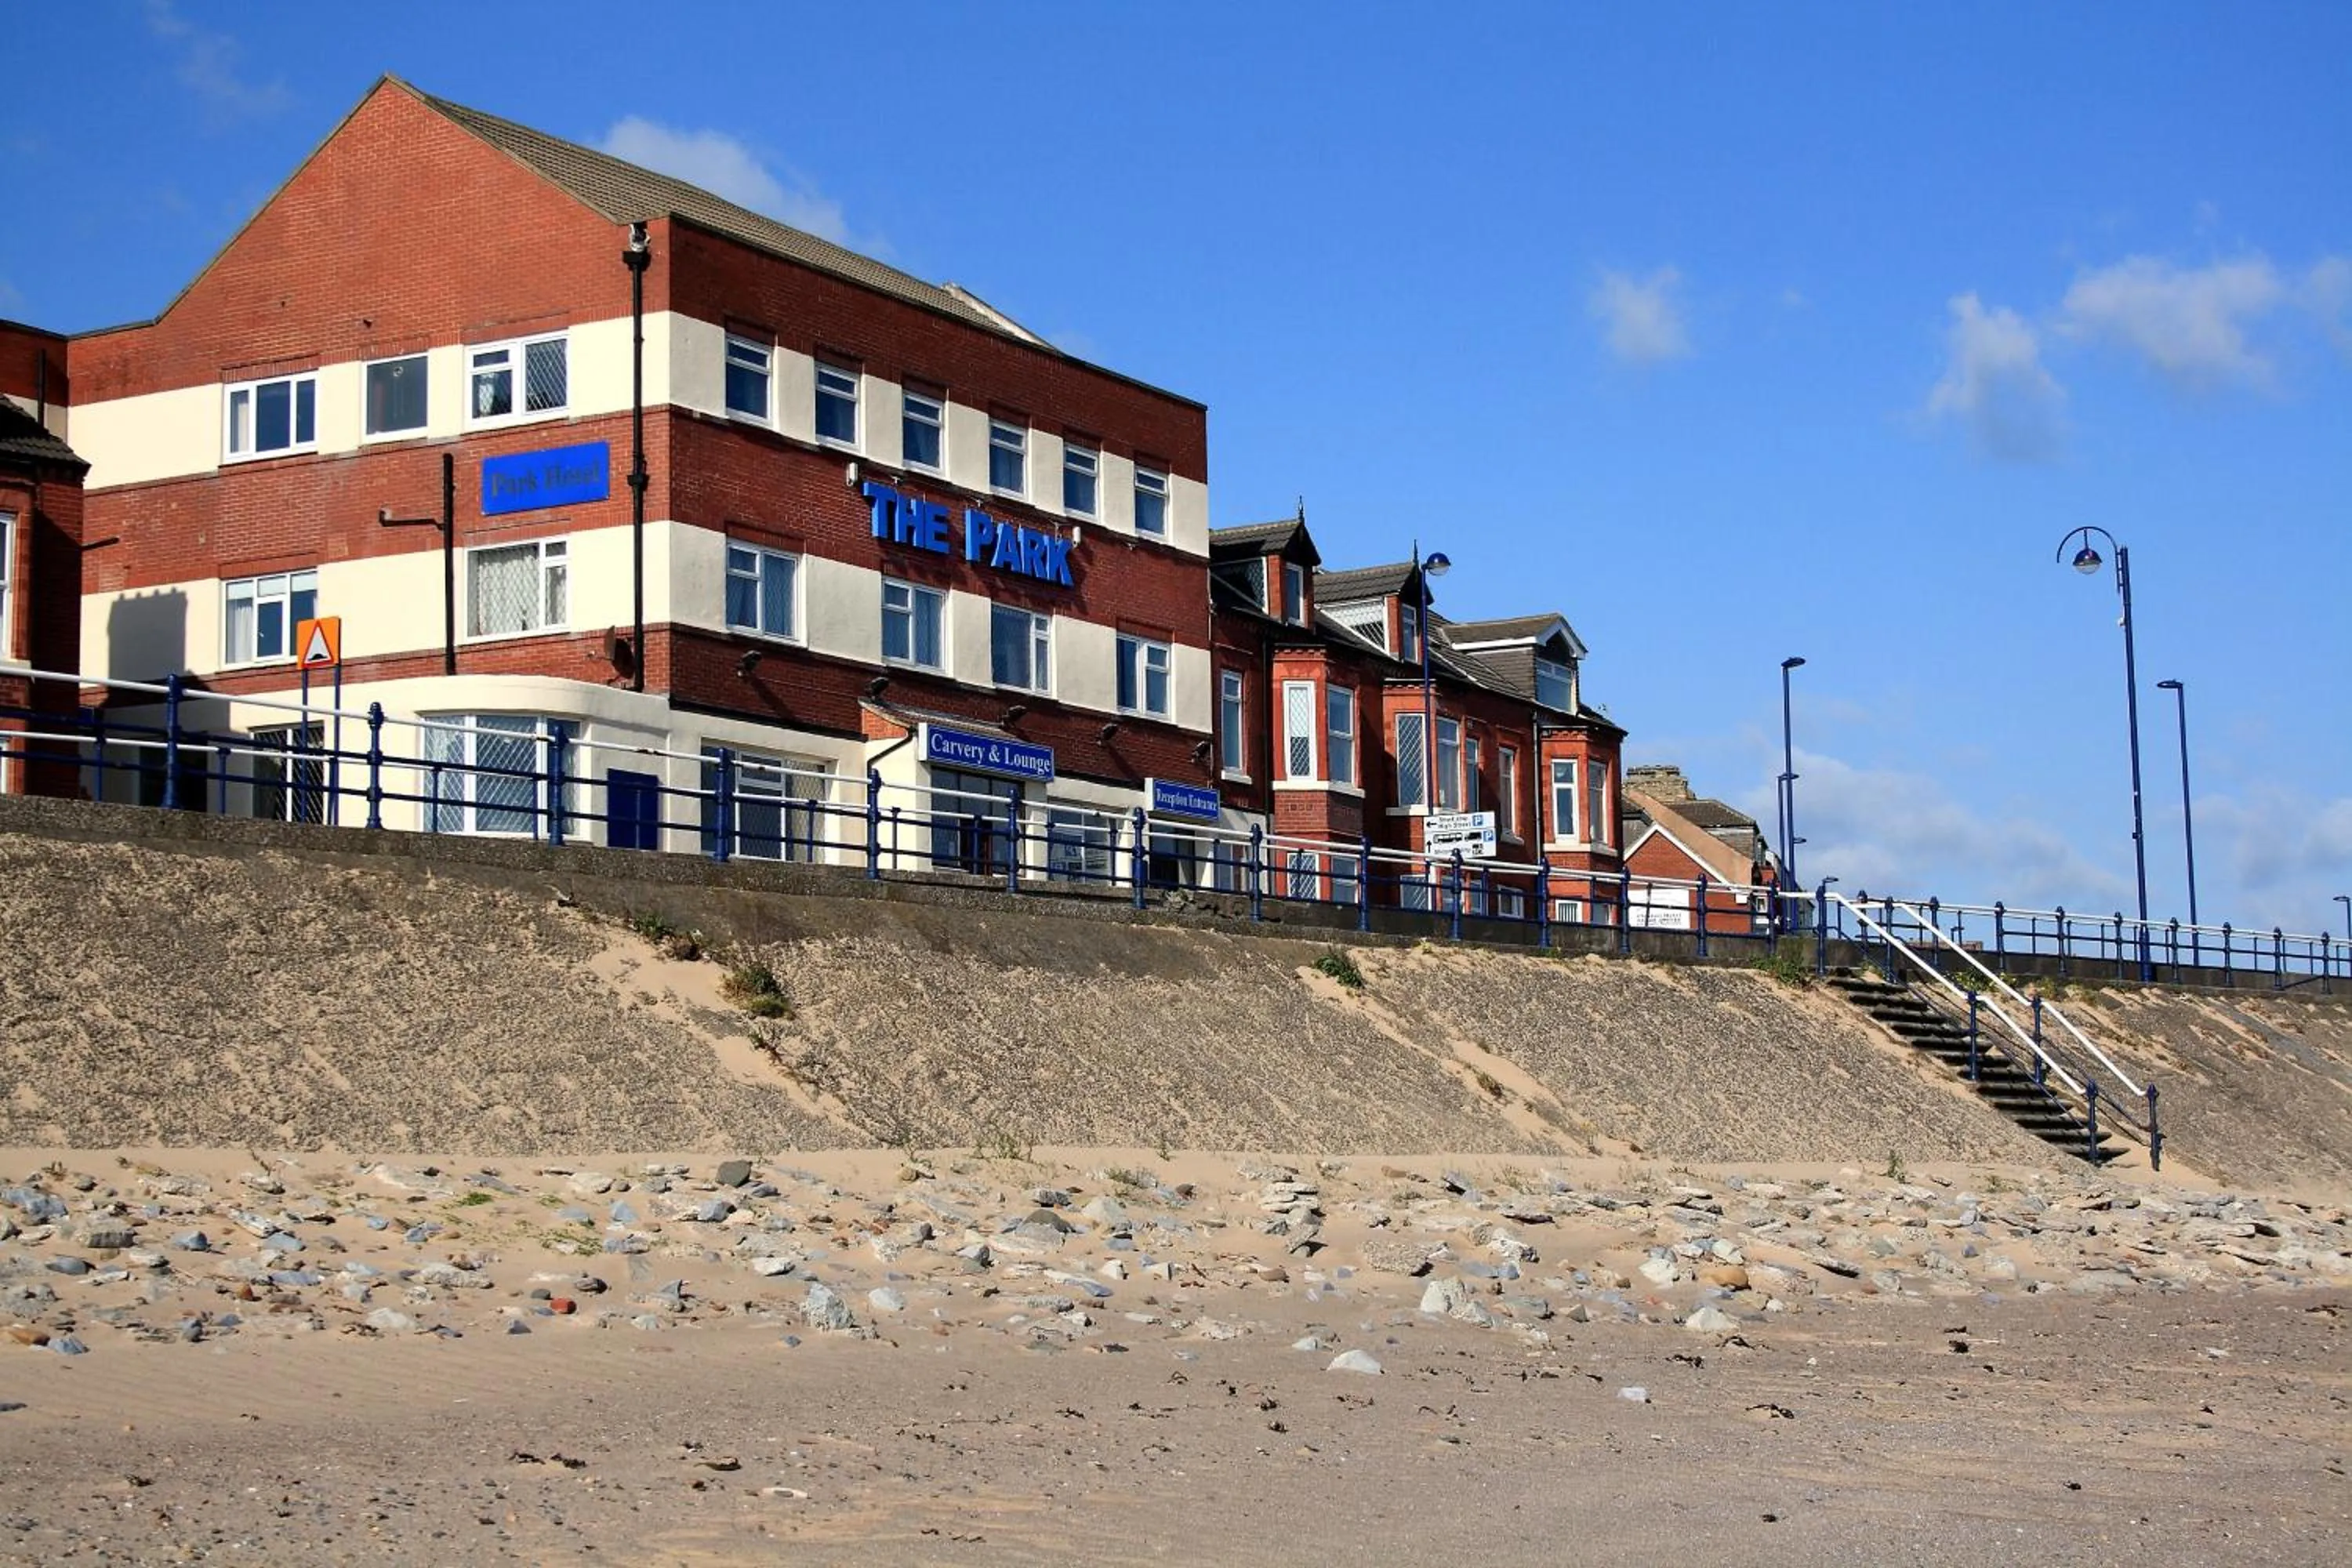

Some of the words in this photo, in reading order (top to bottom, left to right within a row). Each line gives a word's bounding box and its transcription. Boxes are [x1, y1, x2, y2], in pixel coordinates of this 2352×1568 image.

[492, 470, 537, 497] Park
[544, 461, 600, 489] Hotel
[863, 480, 950, 554] THE
[965, 507, 1075, 586] PARK
[931, 733, 985, 764] Carvery
[989, 744, 1000, 763] &
[1005, 747, 1051, 775] Lounge
